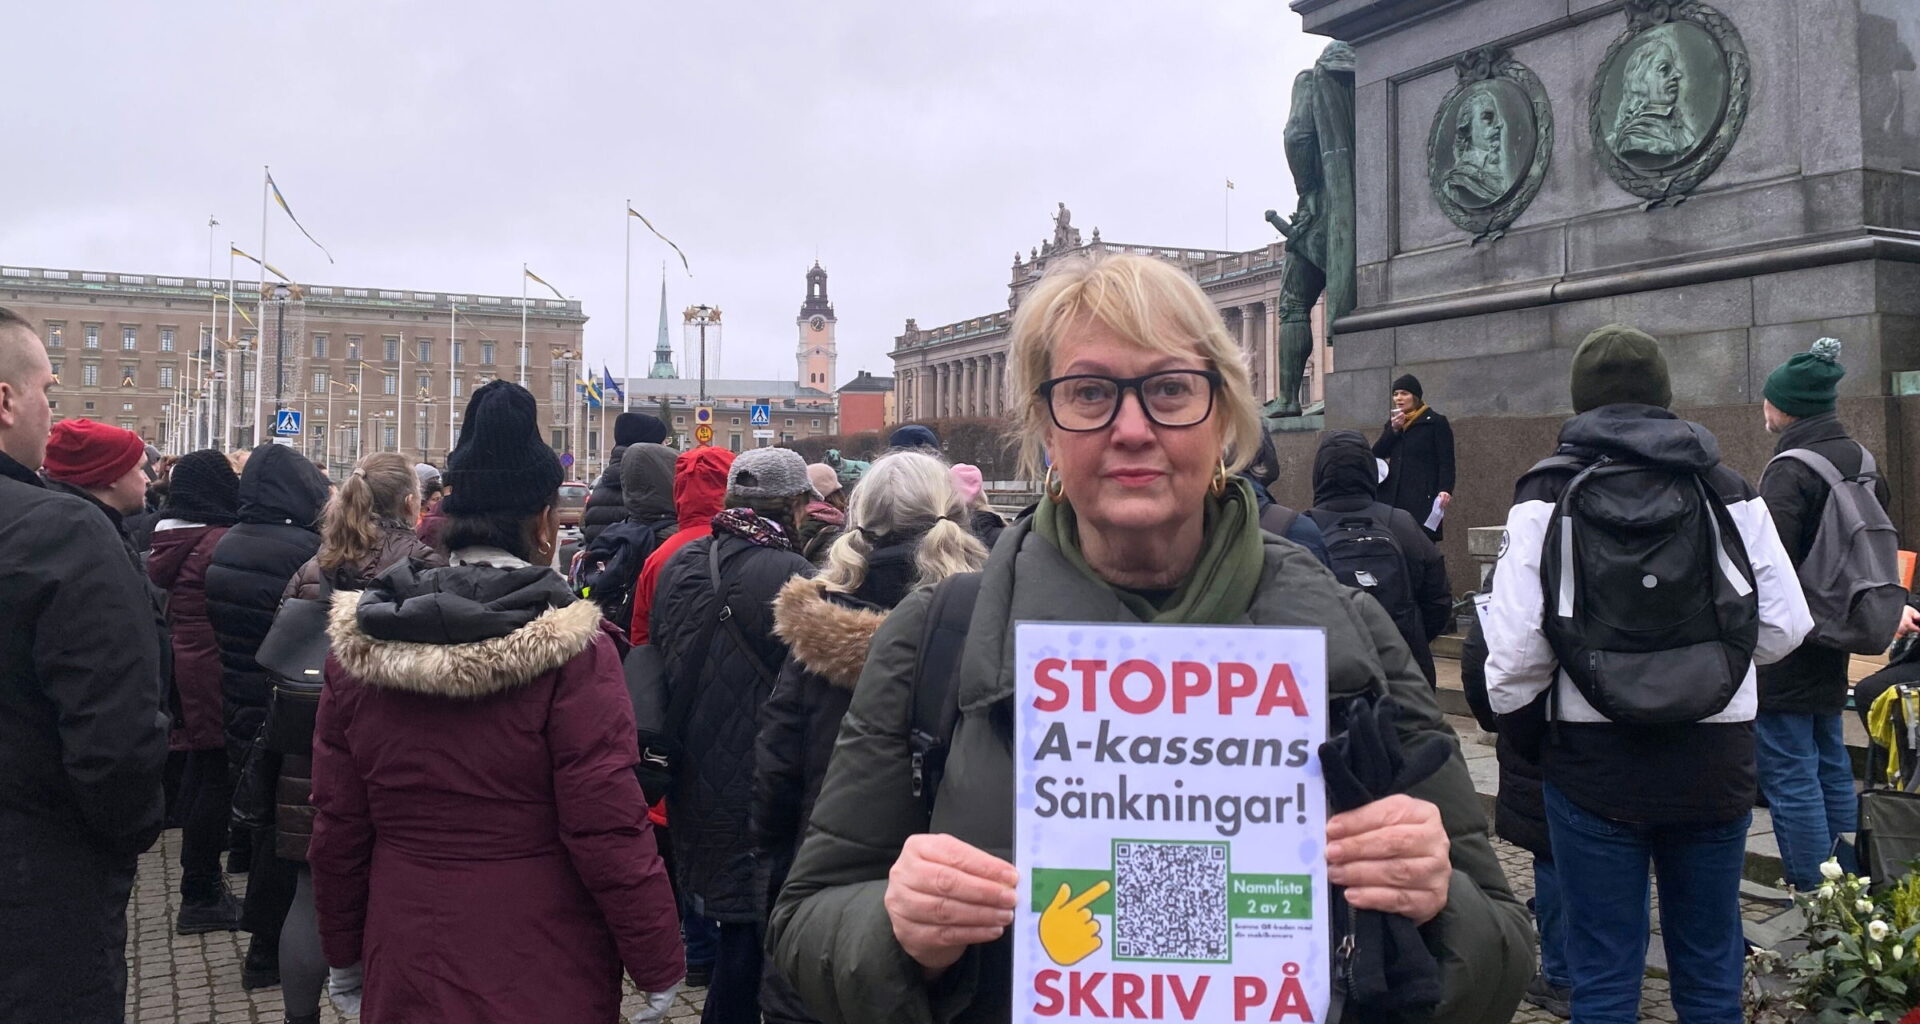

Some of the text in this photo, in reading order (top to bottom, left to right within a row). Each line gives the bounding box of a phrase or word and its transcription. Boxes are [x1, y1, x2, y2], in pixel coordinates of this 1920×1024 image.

[1033, 658, 1309, 717] STOPPA
[1033, 719, 1309, 767] A-kassans
[1034, 774, 1307, 837] Sänkningar!
[1233, 878, 1304, 895] Namnlista
[1247, 899, 1292, 915] 2 av 2
[1033, 961, 1314, 1022] SKRIV PÅ
